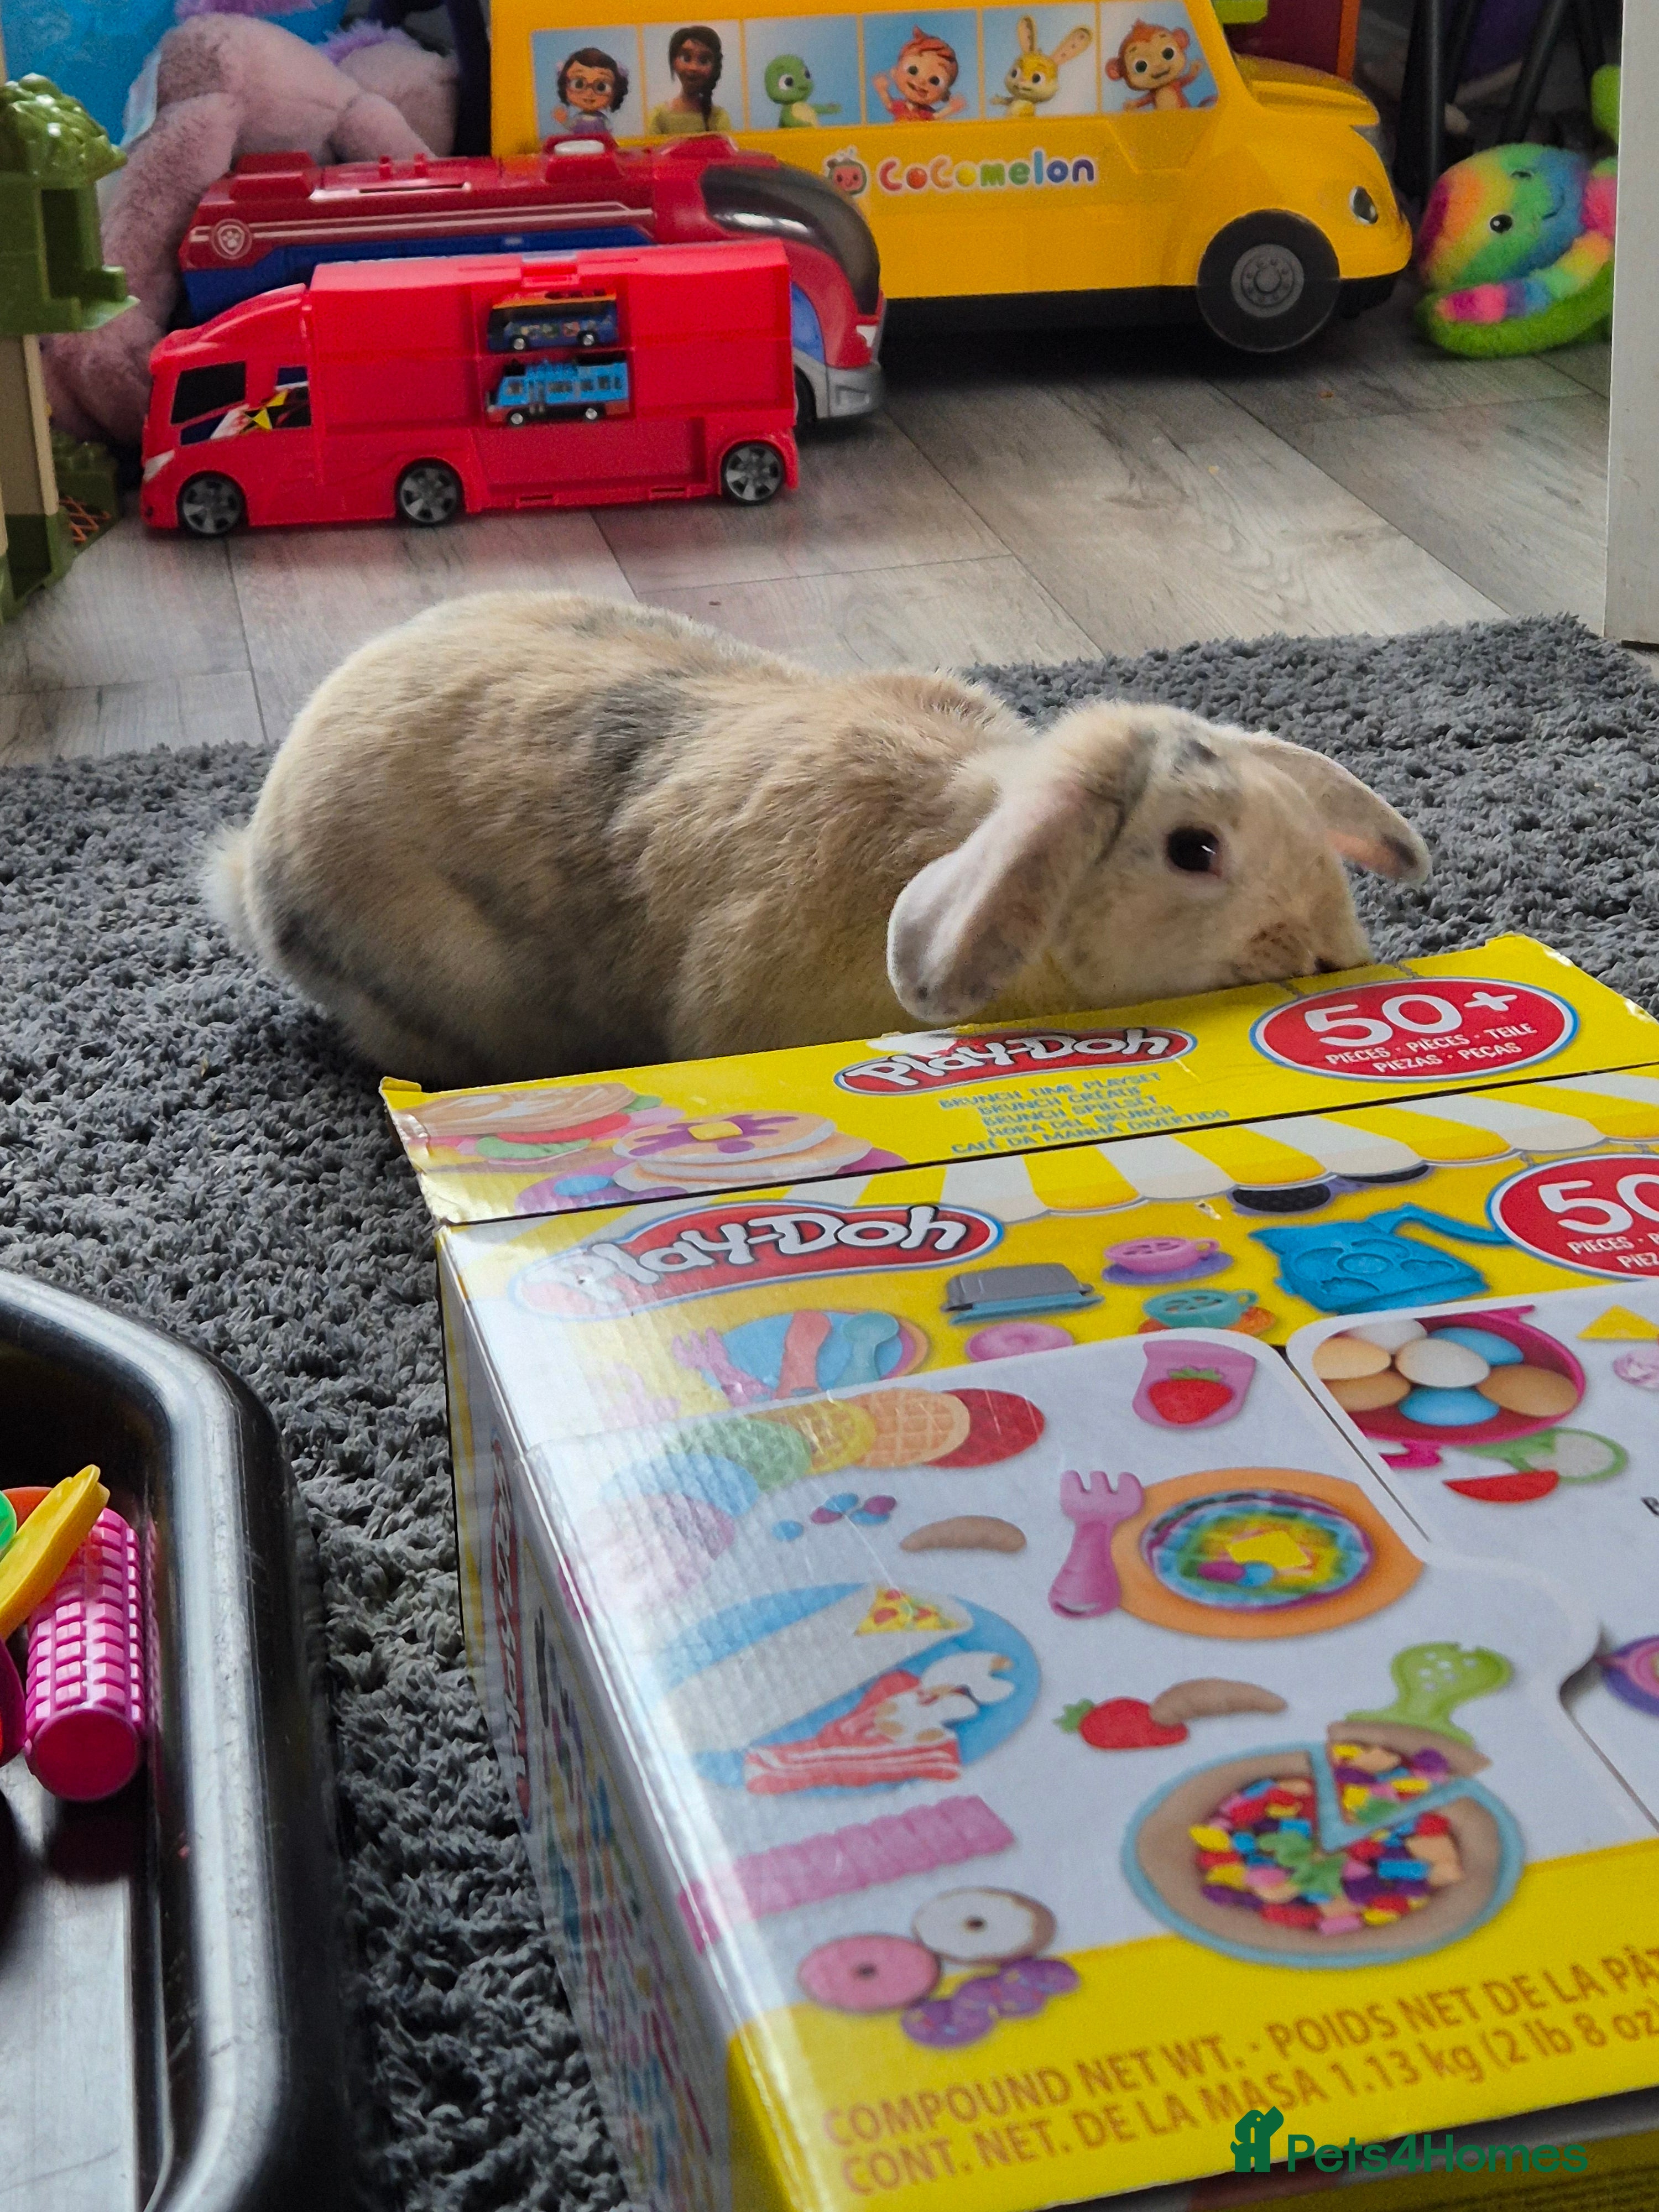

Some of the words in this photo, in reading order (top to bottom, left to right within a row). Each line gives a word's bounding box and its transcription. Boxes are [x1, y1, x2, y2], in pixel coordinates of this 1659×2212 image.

[1303, 992, 1519, 1047] 50+
[843, 1029, 1170, 1086] Play-Doh
[1325, 1047, 1391, 1065] PIECES
[1405, 1034, 1470, 1053] PIÈCES
[1483, 1022, 1538, 1040] TEILE
[1372, 1054, 1443, 1073] PIEZAS
[1458, 1042, 1522, 1061] PEÇAS
[939, 1090, 1022, 1107] BRUNCH
[1029, 1083, 1075, 1098] TIME
[1082, 1072, 1161, 1089] PLAYSET
[978, 1097, 1062, 1116] BRUNCH
[982, 1108, 1067, 1126] BRUNCH
[987, 1123, 1046, 1138] HORA
[1094, 1104, 1175, 1123] BRUNCH
[1006, 1135, 1038, 1147] DA
[1126, 1109, 1231, 1130] DIVERTIDO
[524, 1204, 966, 1303] Play-Doh
[1567, 1236, 1635, 1255] PIECES
[822, 2065, 1072, 2148] COMPOUND
[1074, 2048, 1159, 2099] NET
[1160, 2032, 1245, 2079] WT.
[1264, 2002, 1399, 2059] POIDS
[1397, 1986, 1481, 2033] NET
[1482, 1974, 1547, 2017] DE
[1543, 1964, 1609, 2004] LA
[841, 2136, 974, 2197] CONT.
[972, 2117, 1071, 2170] NET.
[1071, 2104, 1141, 2151] DE
[1135, 2090, 1199, 2137] LA
[1197, 2067, 1331, 2125] MASA
[1330, 2049, 1422, 2098] 1.13
[1416, 2041, 1485, 2084] kg
[1477, 2028, 1531, 2072] (2
[1522, 2017, 1574, 2058] lb
[1572, 2012, 1609, 2048] 8
